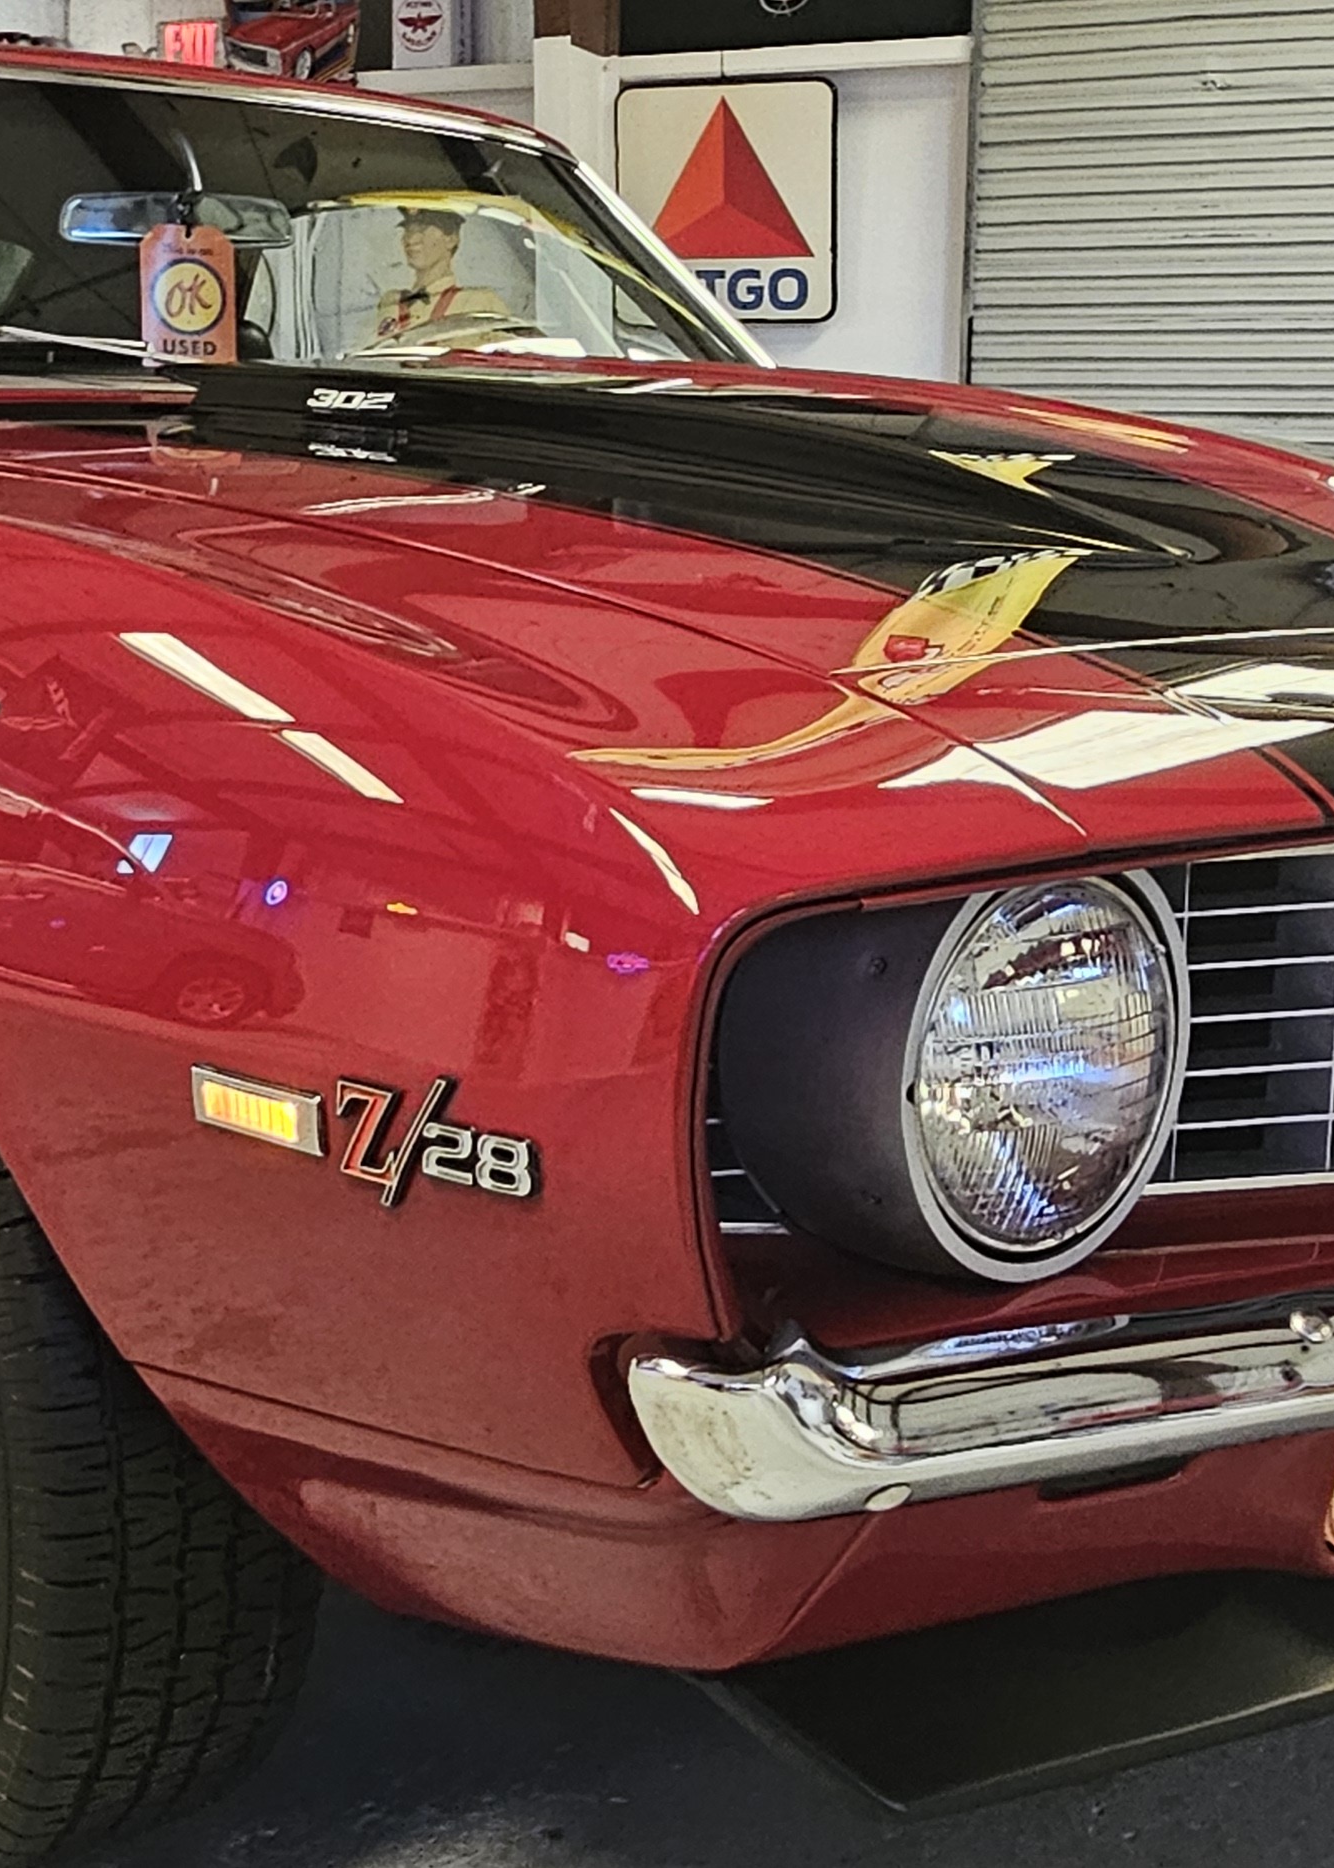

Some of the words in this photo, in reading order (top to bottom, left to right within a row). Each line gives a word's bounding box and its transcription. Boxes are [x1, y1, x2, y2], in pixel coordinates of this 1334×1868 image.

[165, 23, 216, 67] EXIT
[165, 272, 213, 318] OK
[694, 268, 809, 311] TGO
[163, 338, 217, 356] USED
[307, 387, 396, 411] 302
[336, 1076, 535, 1208] Z/28
